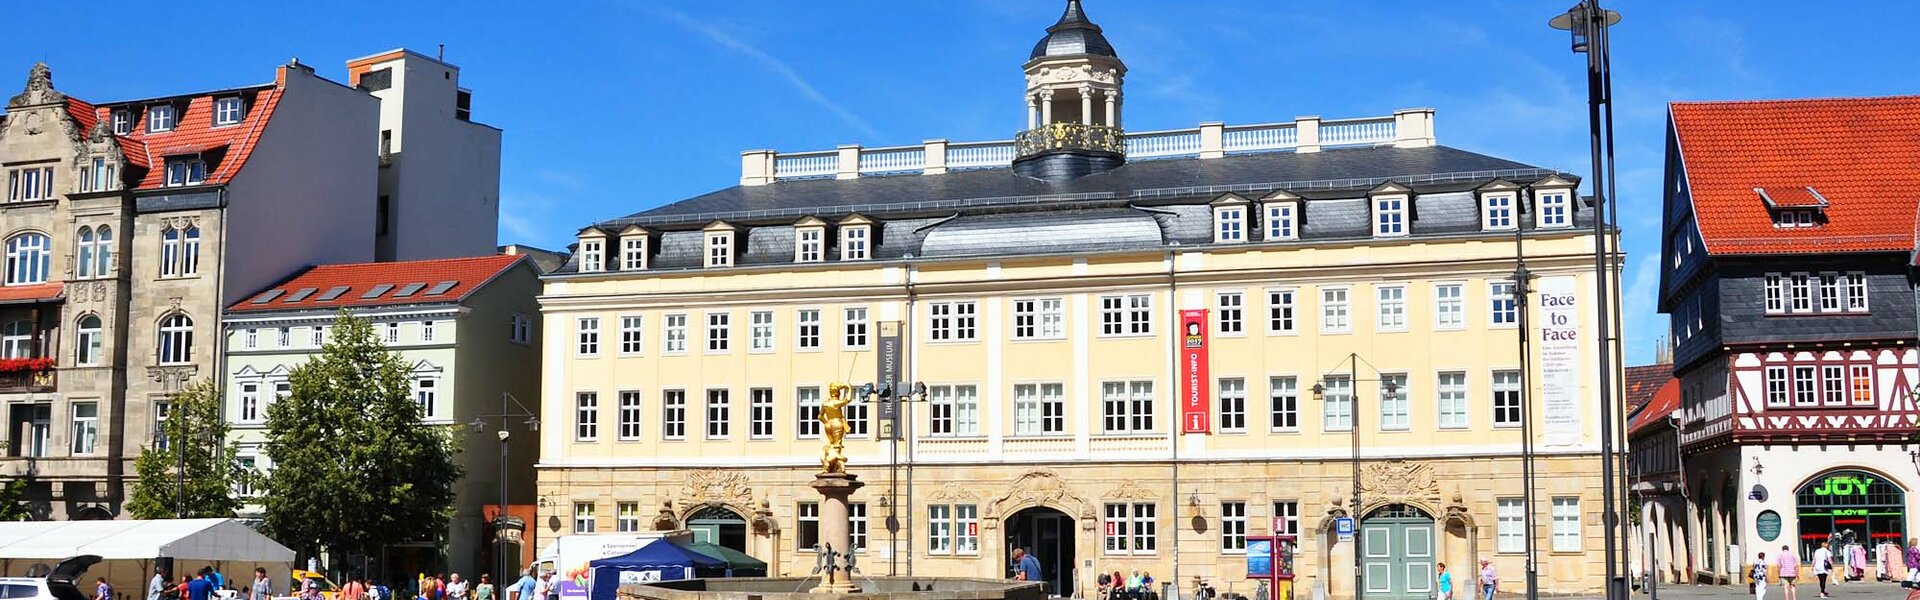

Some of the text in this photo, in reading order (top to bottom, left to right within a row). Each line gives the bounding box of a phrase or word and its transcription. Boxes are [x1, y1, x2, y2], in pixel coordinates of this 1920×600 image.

[1541, 293, 1575, 306] Face
[1551, 312, 1567, 325] to
[1542, 328, 1576, 341] Face
[885, 340, 893, 373] MUSEUM
[1190, 353, 1198, 407] TOURIST-INFO
[1814, 477, 1873, 496] JOY
